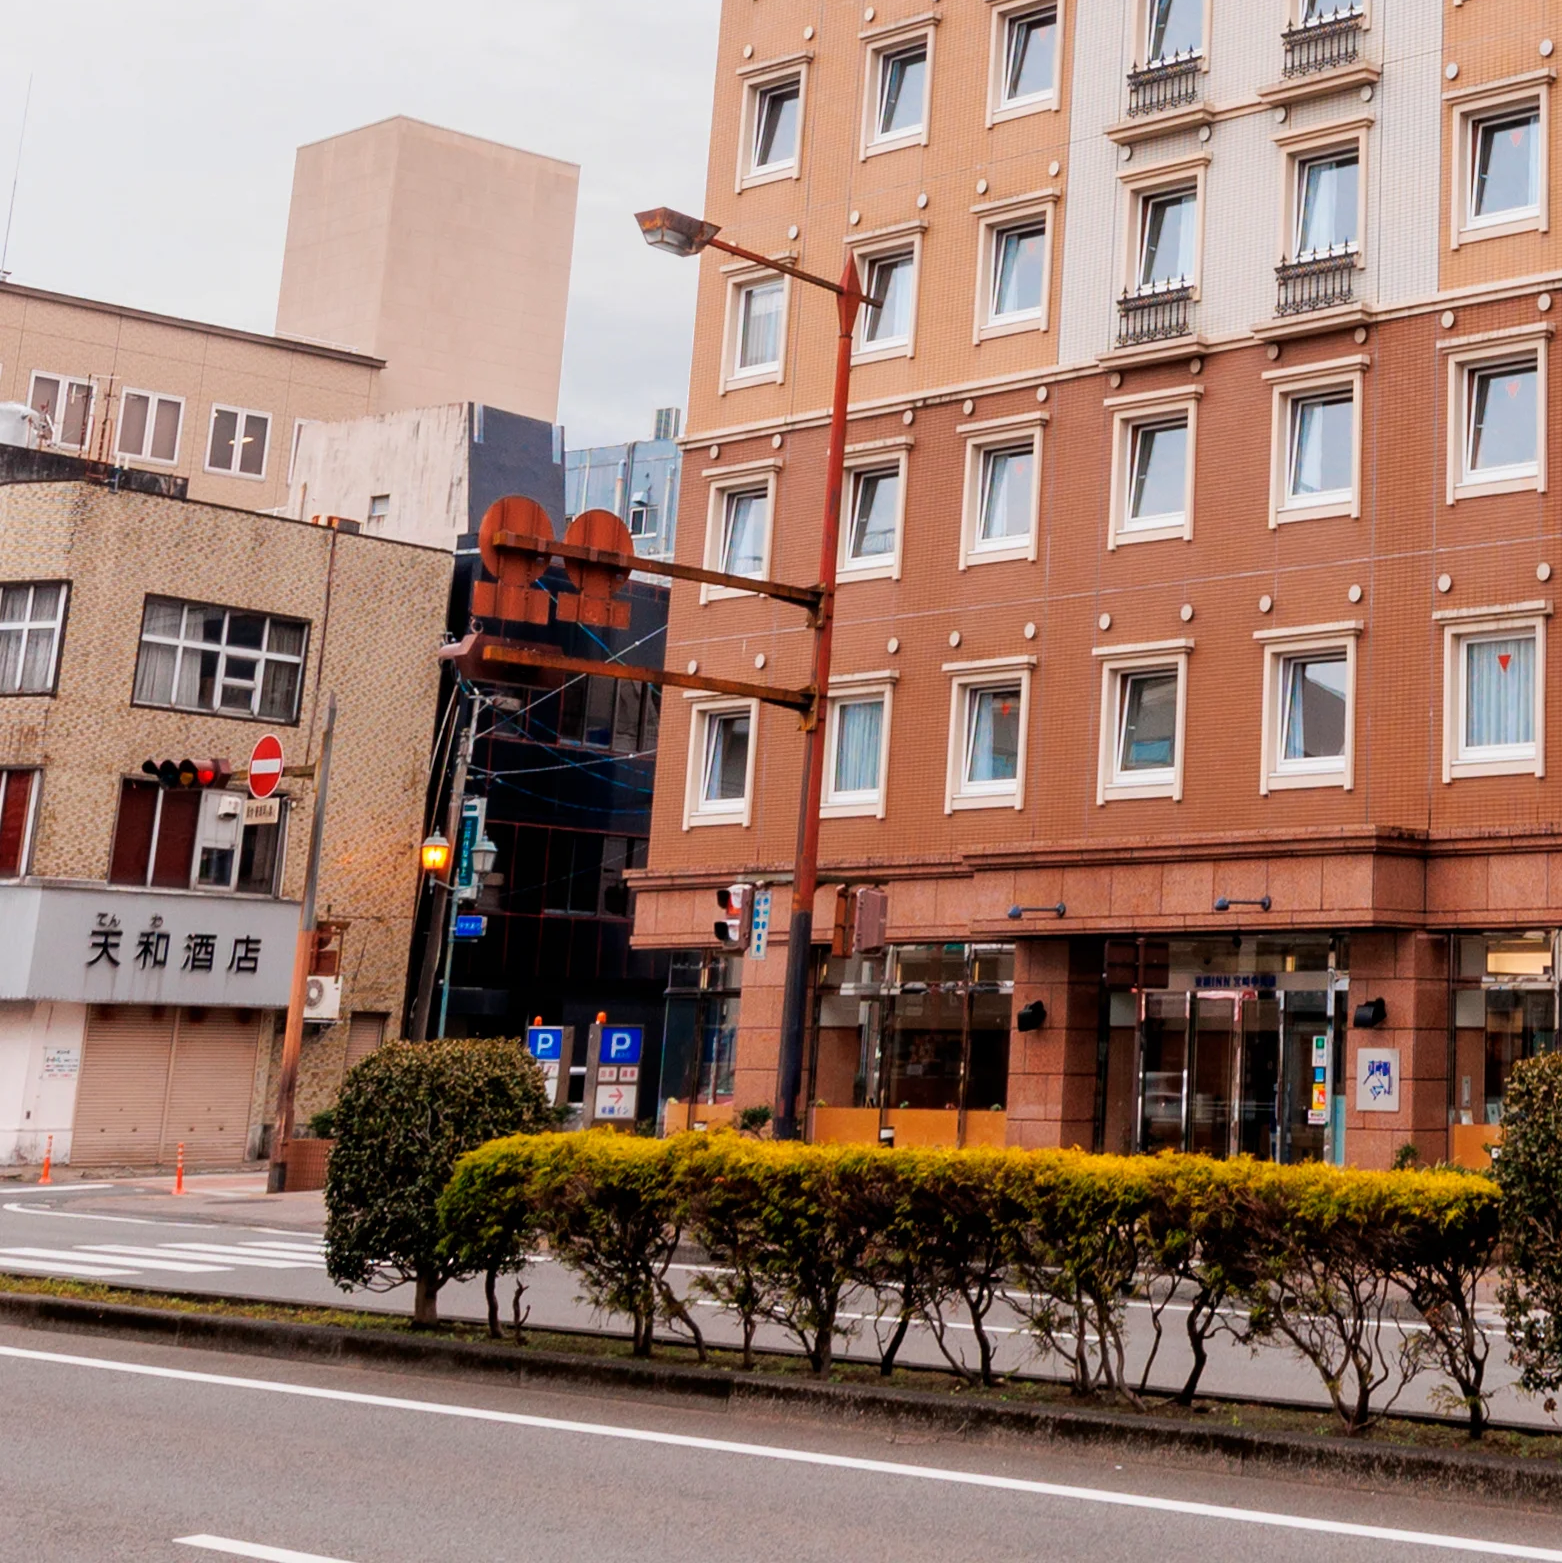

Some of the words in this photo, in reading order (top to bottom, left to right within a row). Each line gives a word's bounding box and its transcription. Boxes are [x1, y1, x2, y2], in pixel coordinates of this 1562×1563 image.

[86, 929, 262, 975] 天和酒店
[537, 1033, 554, 1056] P
[611, 1032, 631, 1059] P
